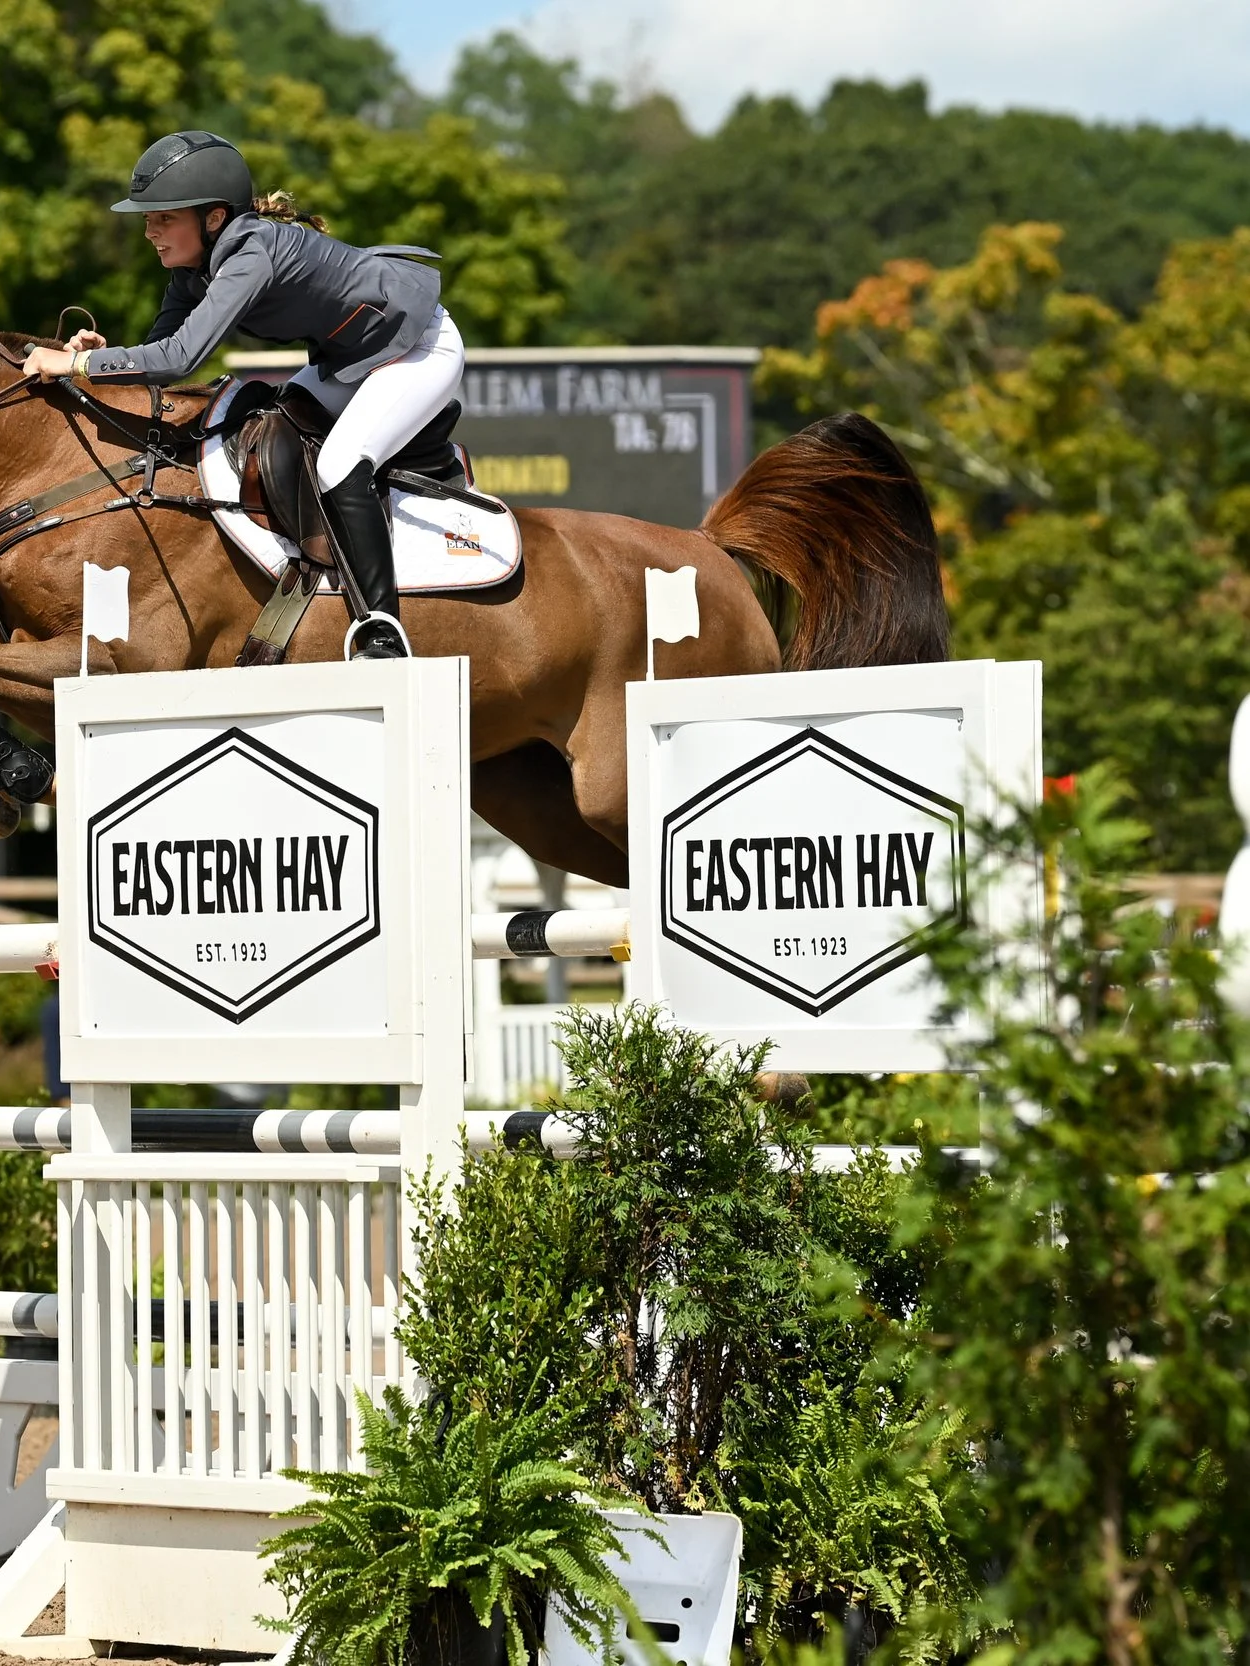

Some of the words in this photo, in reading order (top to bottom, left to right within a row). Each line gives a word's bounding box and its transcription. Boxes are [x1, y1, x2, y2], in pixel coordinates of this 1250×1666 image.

[556, 366, 664, 415] FARM
[446, 539, 480, 549] ELAN
[112, 837, 264, 917] EASTERN
[275, 834, 350, 913] HAY
[686, 835, 845, 912] EASTERN
[855, 832, 935, 908] HAY
[196, 943, 227, 963] EST.
[231, 942, 268, 962] 1923
[773, 937, 806, 957] EST.
[810, 936, 848, 956] 1923
